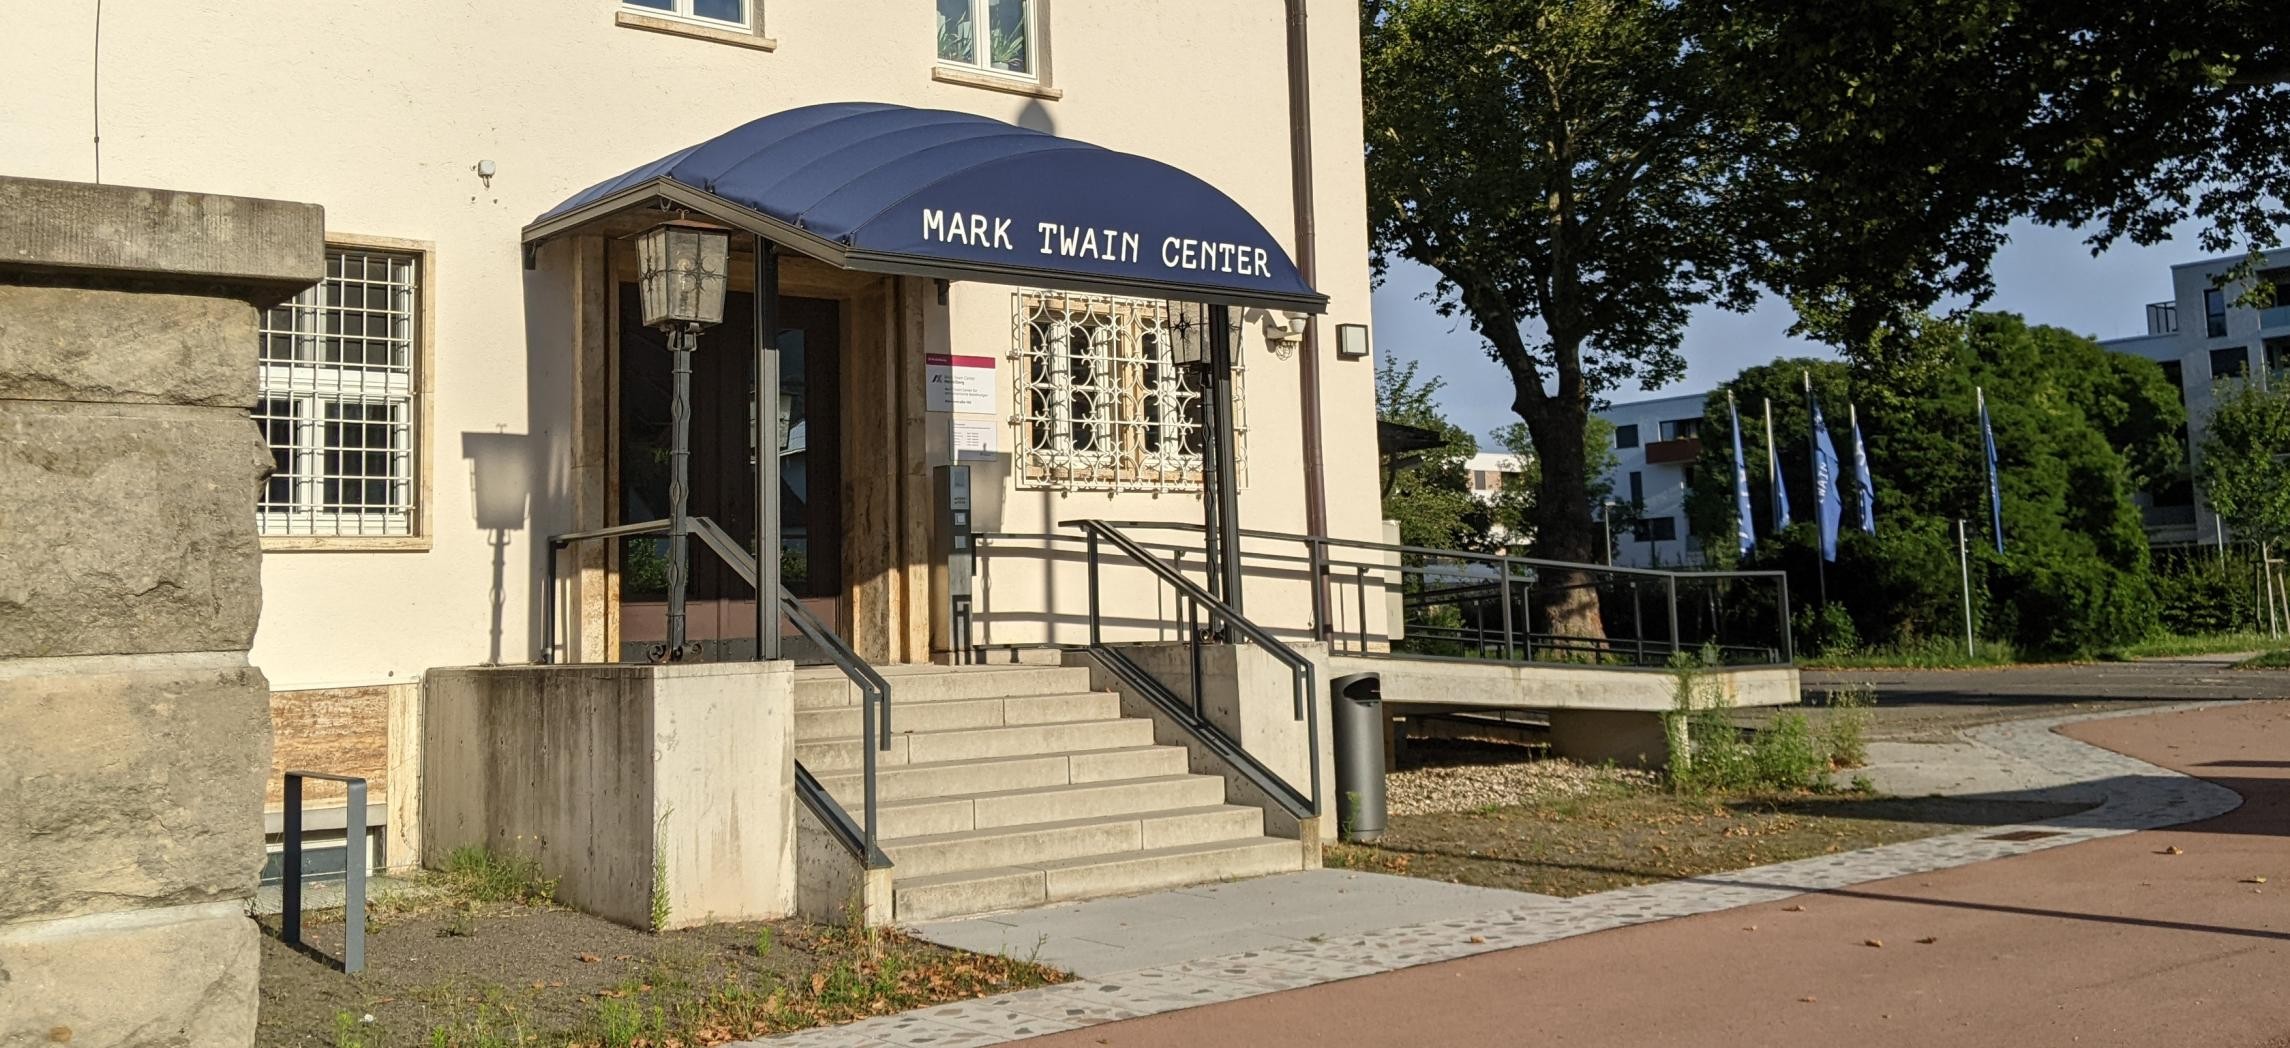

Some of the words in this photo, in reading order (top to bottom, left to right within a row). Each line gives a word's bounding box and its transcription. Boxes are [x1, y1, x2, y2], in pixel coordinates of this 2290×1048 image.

[922, 208, 1014, 250] MARK
[1038, 222, 1139, 263] TWAIN
[1161, 236, 1272, 278] CENTER
